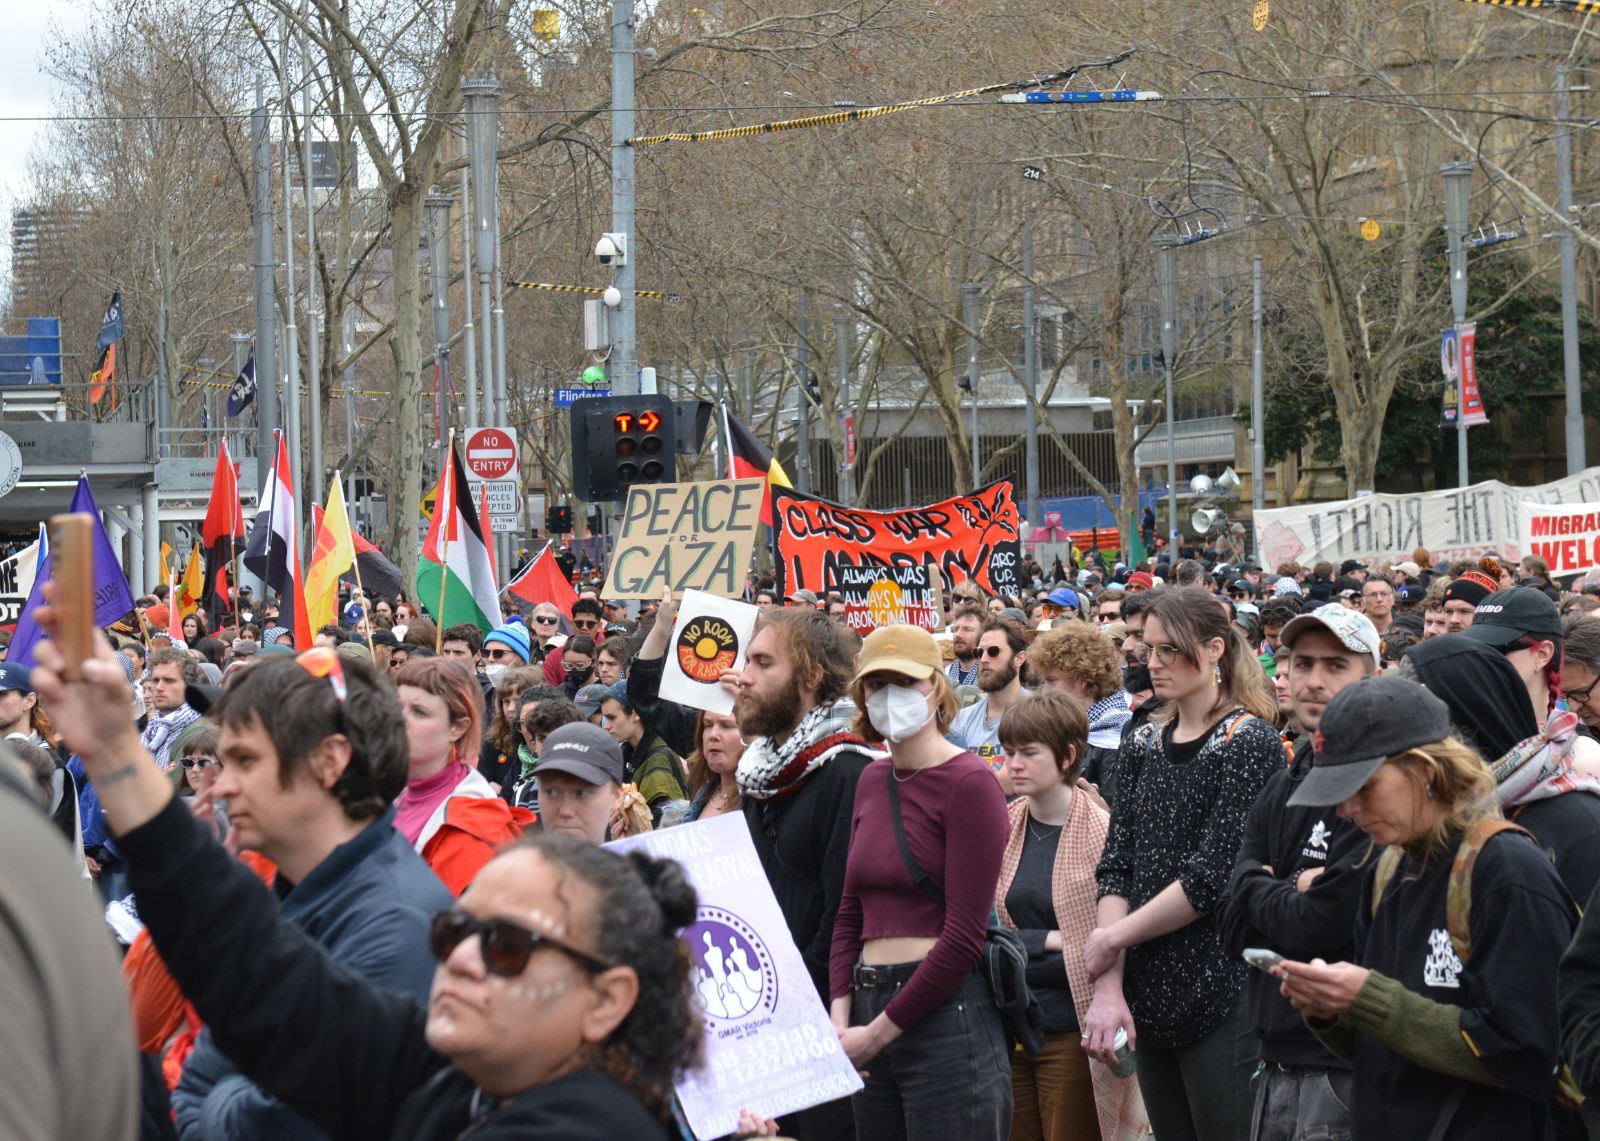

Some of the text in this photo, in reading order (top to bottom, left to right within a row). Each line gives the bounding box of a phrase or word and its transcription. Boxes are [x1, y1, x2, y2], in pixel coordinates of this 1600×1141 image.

[1023, 167, 1040, 180] 214
[483, 437, 498, 447] NO
[473, 461, 509, 471] ENTRY
[622, 483, 760, 538] PEACE
[786, 504, 876, 544] CLASS
[884, 510, 952, 544] WAR
[1530, 511, 1600, 537] MIGRA
[668, 534, 698, 542] FOR
[613, 541, 737, 594] GAZA
[990, 551, 1016, 568] ARC
[843, 566, 926, 585] ALWAYS WAS
[994, 569, 1016, 583] UP.
[844, 588, 938, 609] ALWAYS WILL BE
[683, 620, 734, 646] NO ROOM
[680, 647, 733, 678] FOR RACISM
[691, 849, 761, 890] EMOVAL
[743, 1017, 772, 1032] Victoria
